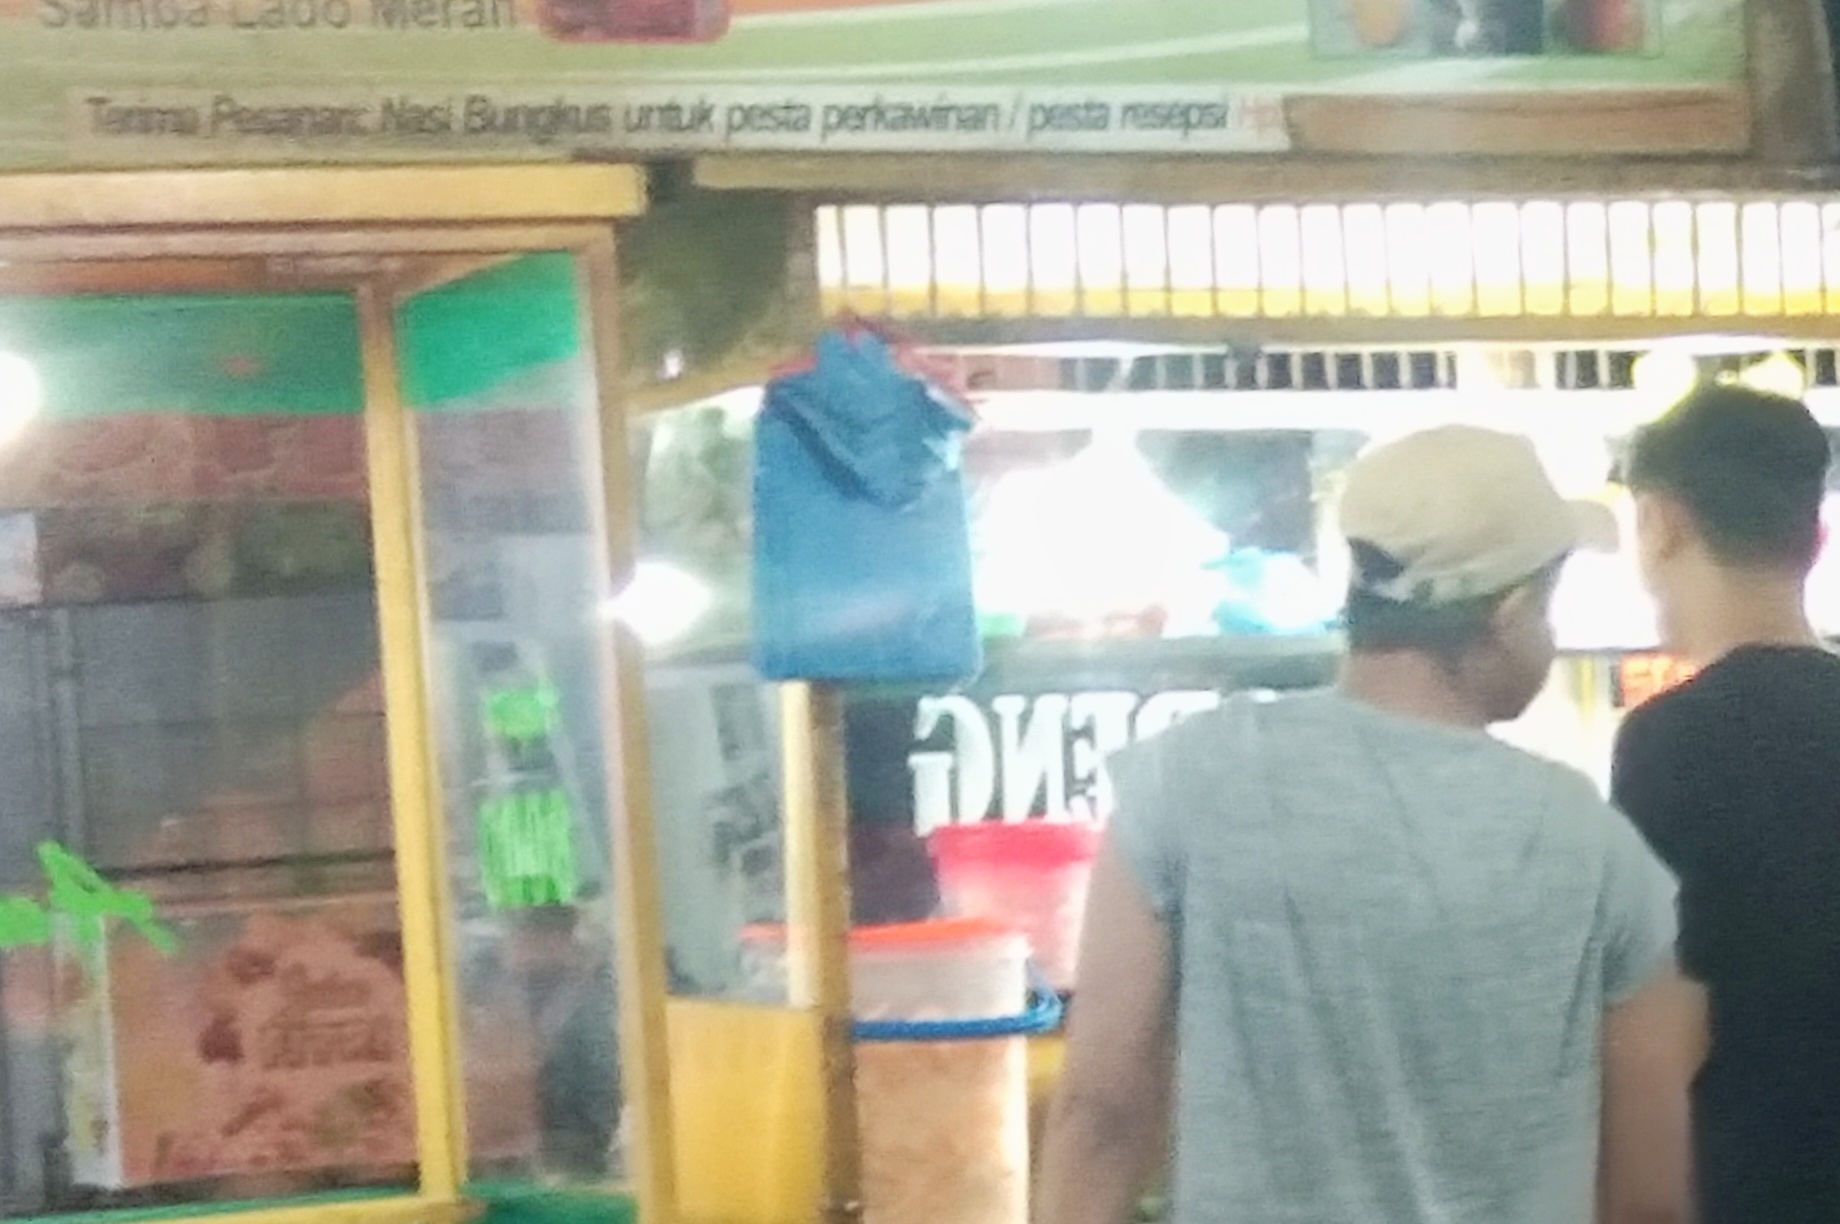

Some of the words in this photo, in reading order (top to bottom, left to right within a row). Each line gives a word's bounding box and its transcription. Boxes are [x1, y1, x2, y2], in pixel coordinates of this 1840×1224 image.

[381, 95, 452, 134] Nasi
[463, 95, 612, 143] Bungkus
[623, 97, 716, 133] untuk
[725, 99, 811, 141] pesta
[821, 97, 999, 142] perkawinan
[1026, 99, 1110, 141] pesta
